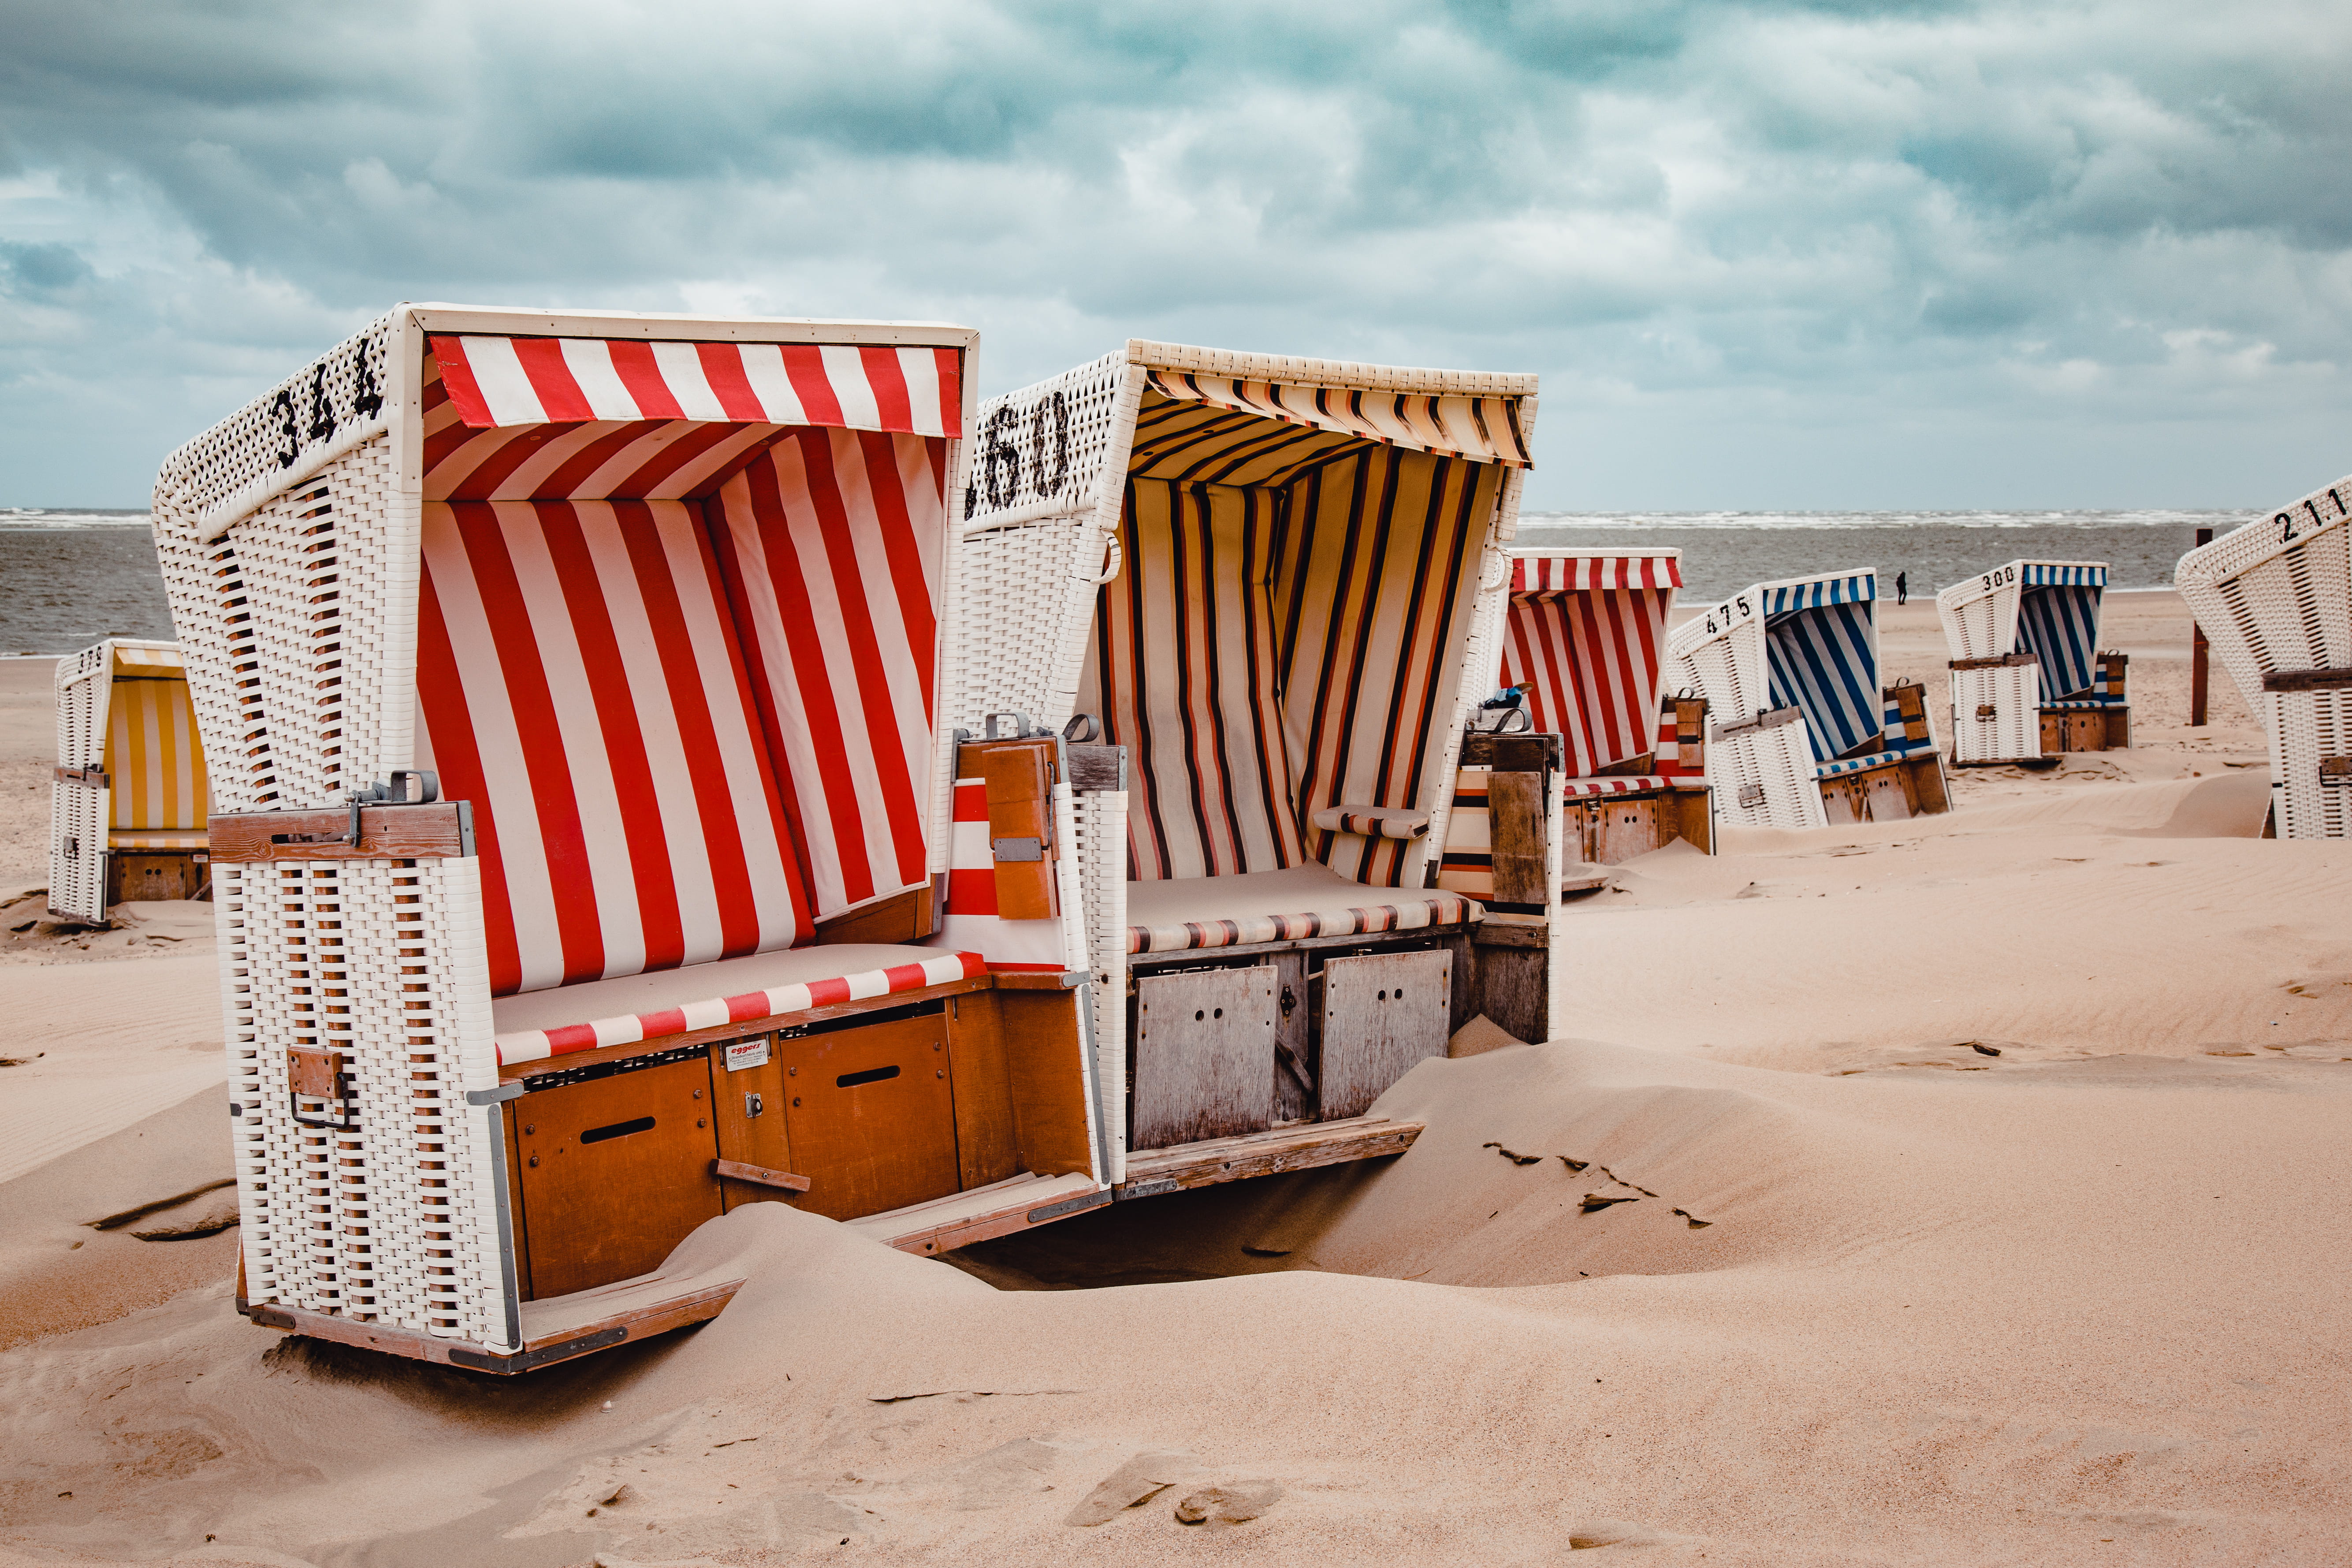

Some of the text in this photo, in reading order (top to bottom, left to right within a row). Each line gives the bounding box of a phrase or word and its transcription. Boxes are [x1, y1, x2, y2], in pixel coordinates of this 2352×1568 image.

[271, 338, 383, 469] 344
[964, 391, 1069, 521] 60
[2274, 488, 2347, 542] 211
[1984, 566, 2013, 591] 300
[1707, 596, 1750, 633] 475
[731, 1043, 761, 1055] eggers
